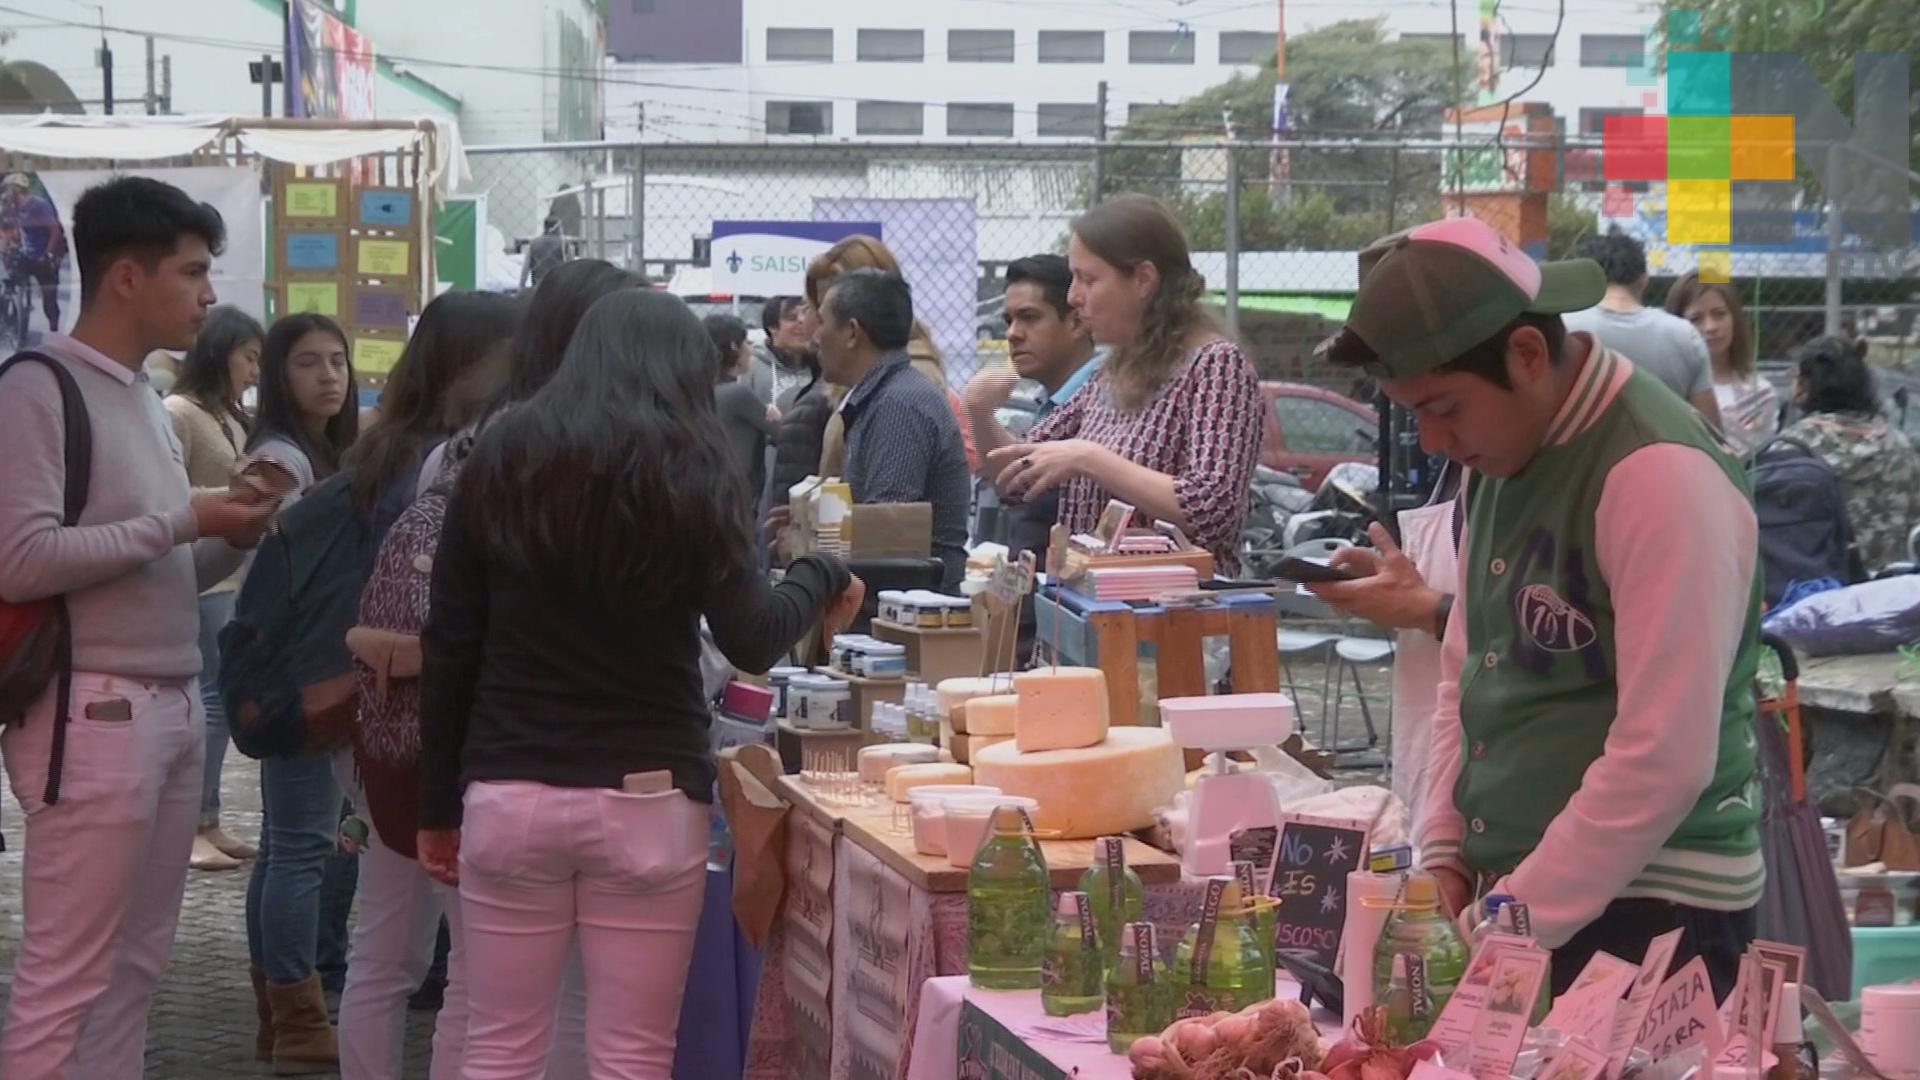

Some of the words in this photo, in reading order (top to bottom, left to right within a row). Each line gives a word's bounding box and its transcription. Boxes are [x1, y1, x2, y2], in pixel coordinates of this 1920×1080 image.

[1205, 884, 1221, 922] JUGO
[1139, 927, 1151, 974] NOPAL
[1410, 965, 1424, 1015] NOPAL
[1636, 970, 1704, 1044] OSTAZA
